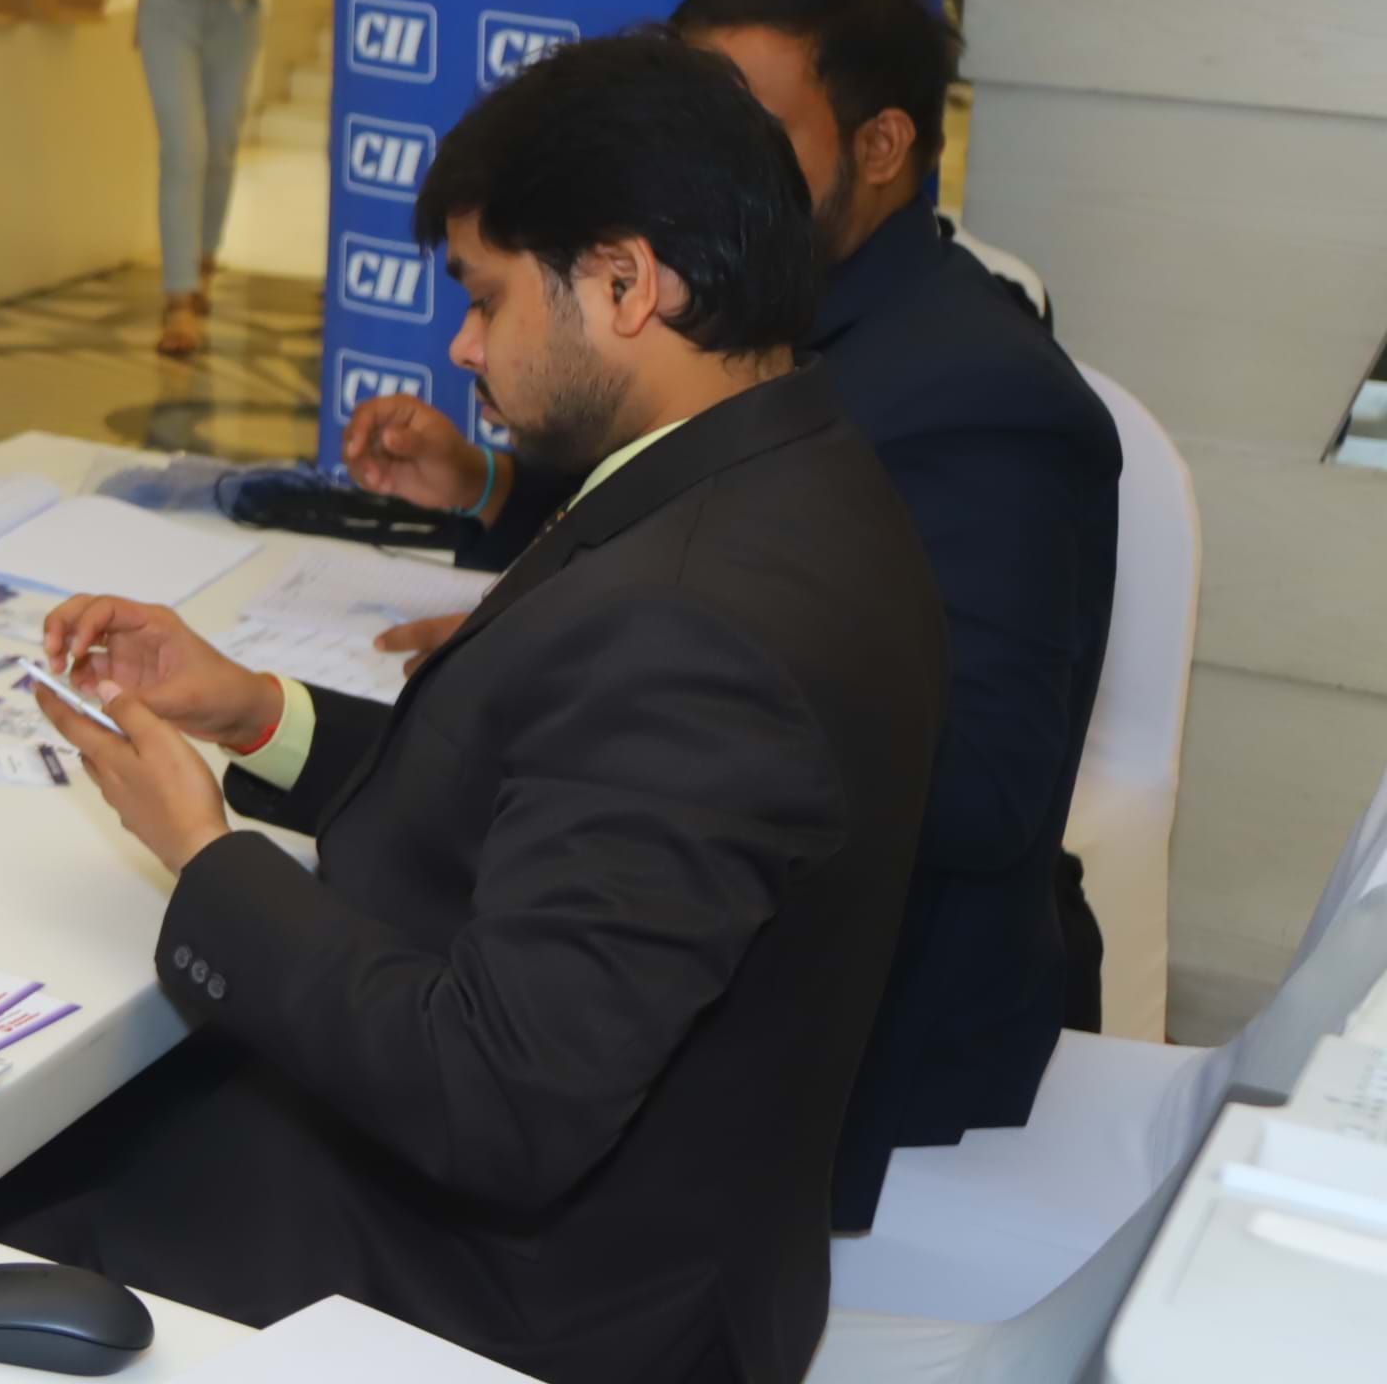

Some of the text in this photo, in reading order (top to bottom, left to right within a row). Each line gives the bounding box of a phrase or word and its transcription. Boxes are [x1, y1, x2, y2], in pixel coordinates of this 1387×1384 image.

[355, 12, 426, 66] CII
[351, 131, 425, 187] CII
[346, 249, 422, 306] CII
